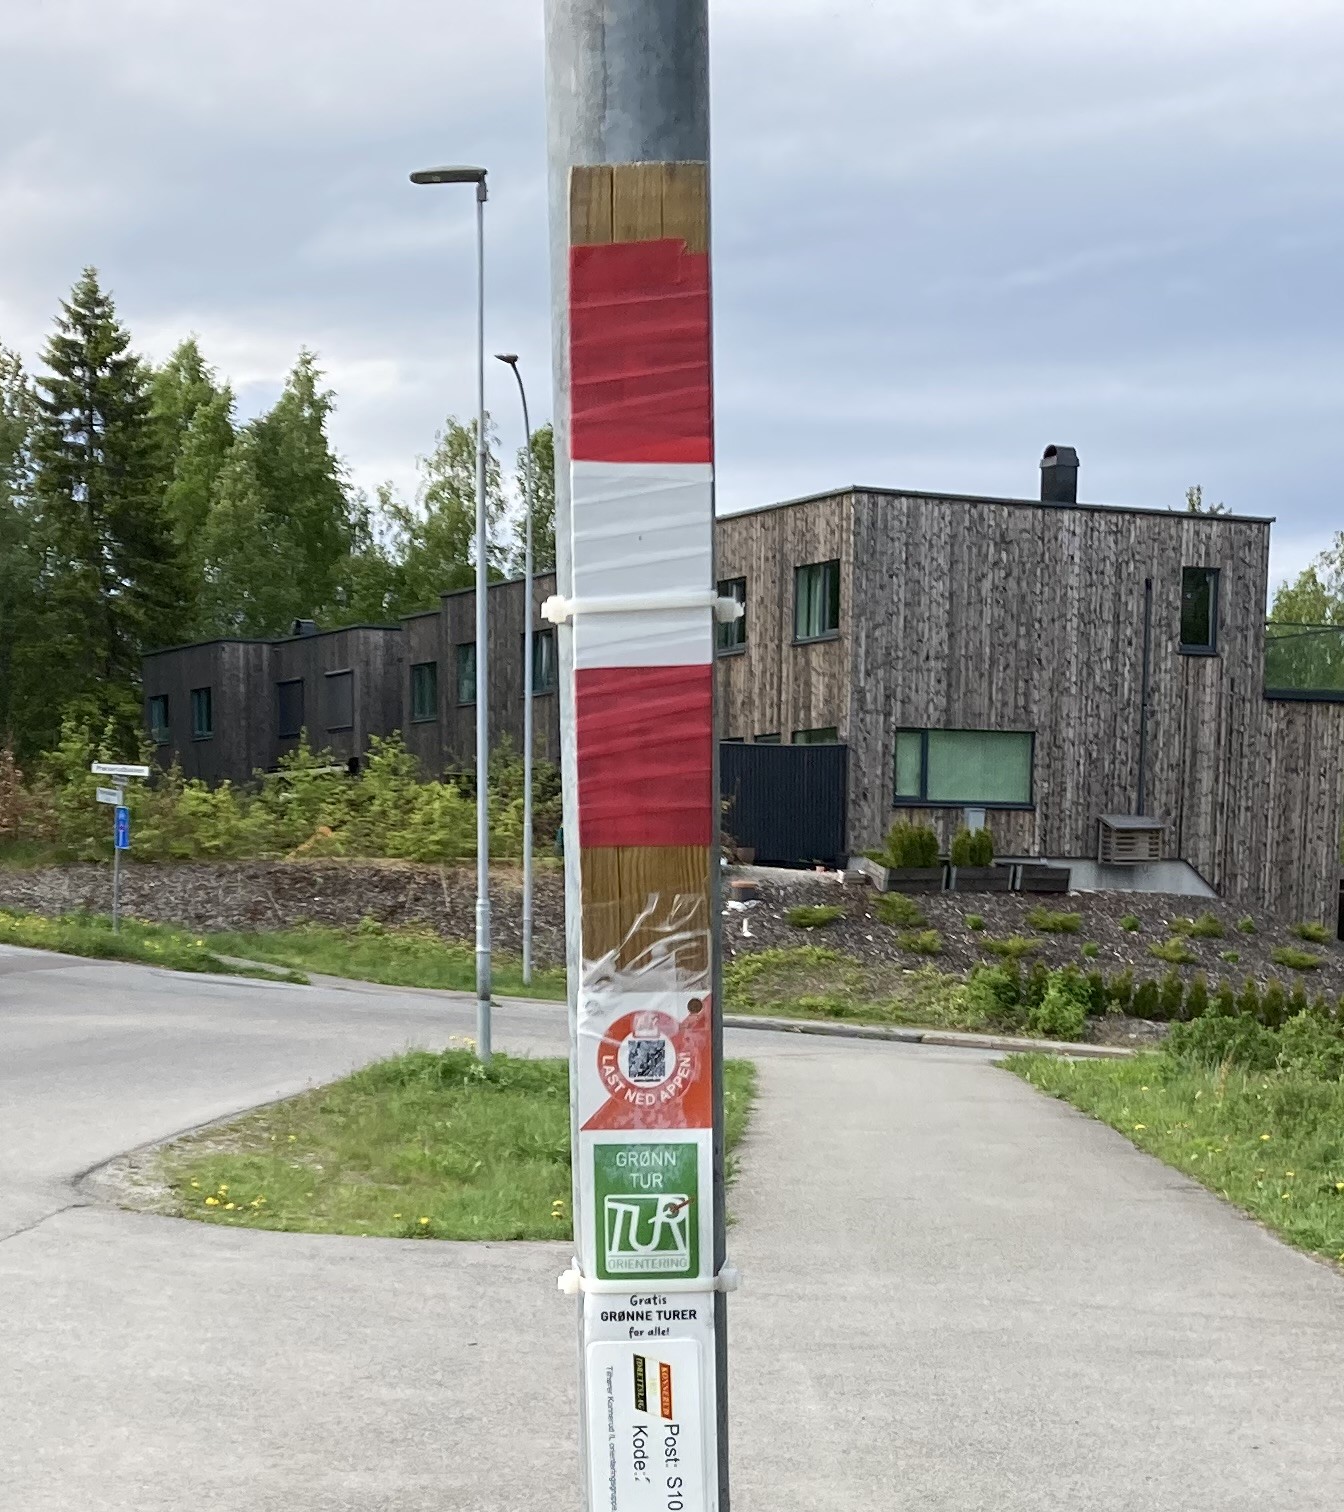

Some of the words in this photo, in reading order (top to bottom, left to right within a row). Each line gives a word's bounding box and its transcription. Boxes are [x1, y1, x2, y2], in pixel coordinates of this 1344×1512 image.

[602, 1055, 626, 1093] LAST
[624, 1088, 656, 1106] NED
[616, 1150, 676, 1167] GRØNN
[629, 1172, 663, 1189] TUR
[607, 1197, 688, 1254] TUR
[608, 1258, 687, 1270] ORIENTERING
[630, 1294, 667, 1306] Gratis
[600, 1310, 653, 1322] GRØNNE
[656, 1309, 697, 1321] TURER
[629, 1326, 644, 1339] for
[647, 1326, 670, 1337] alle!
[632, 1425, 649, 1475] Kode:
[664, 1424, 680, 1468] Post:
[666, 1476, 684, 1511] S10
